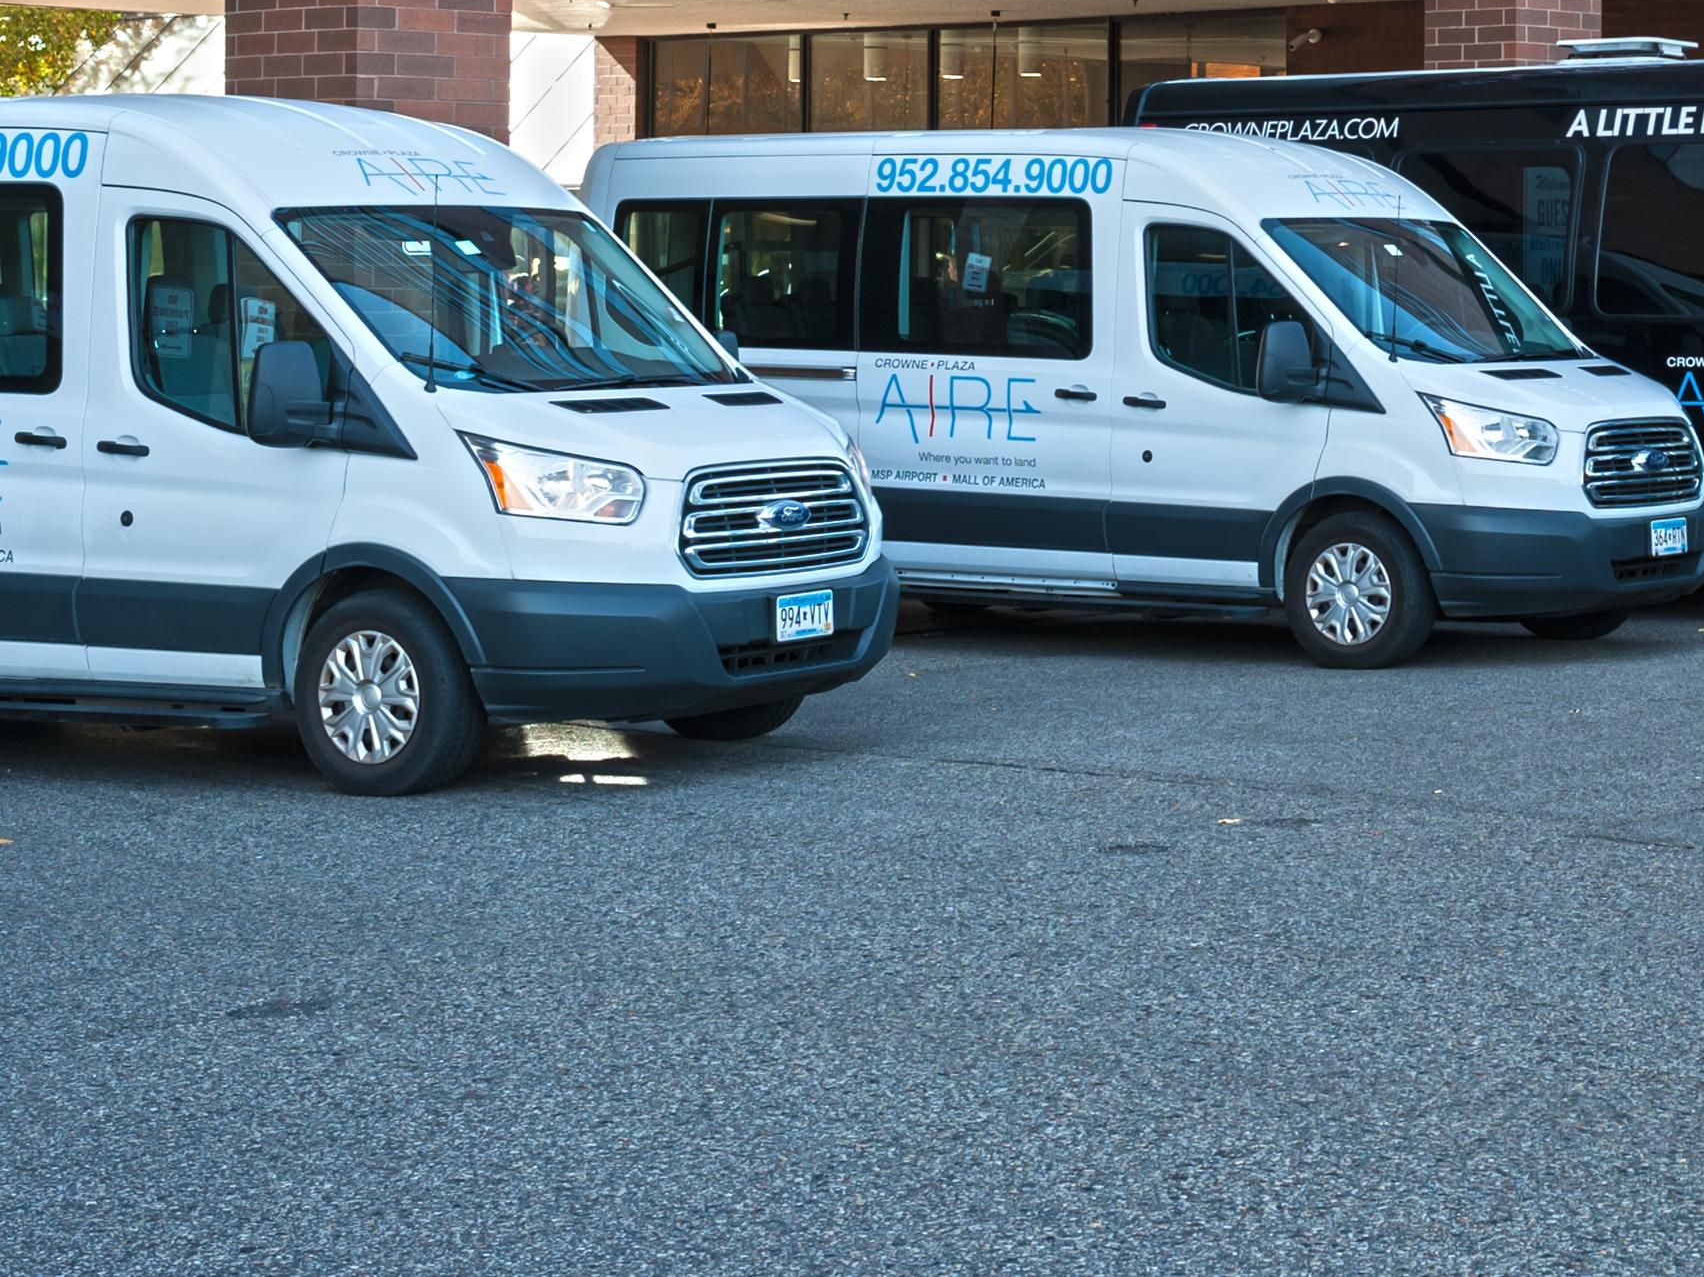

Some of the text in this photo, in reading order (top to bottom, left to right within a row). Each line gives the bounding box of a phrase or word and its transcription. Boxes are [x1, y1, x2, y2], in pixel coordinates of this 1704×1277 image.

[1565, 108, 1590, 138] A
[1595, 106, 1697, 137] LITTLE
[875, 157, 1113, 194] 952.854.9000
[874, 357, 976, 371] CROWNE PLAZA
[874, 373, 1041, 444] AIRE
[918, 452, 1037, 468] Where you want to land
[871, 470, 938, 483] MSP AIRPORT
[951, 474, 1046, 489] MALL OF AMERICA
[780, 601, 830, 630] 994 VTV
